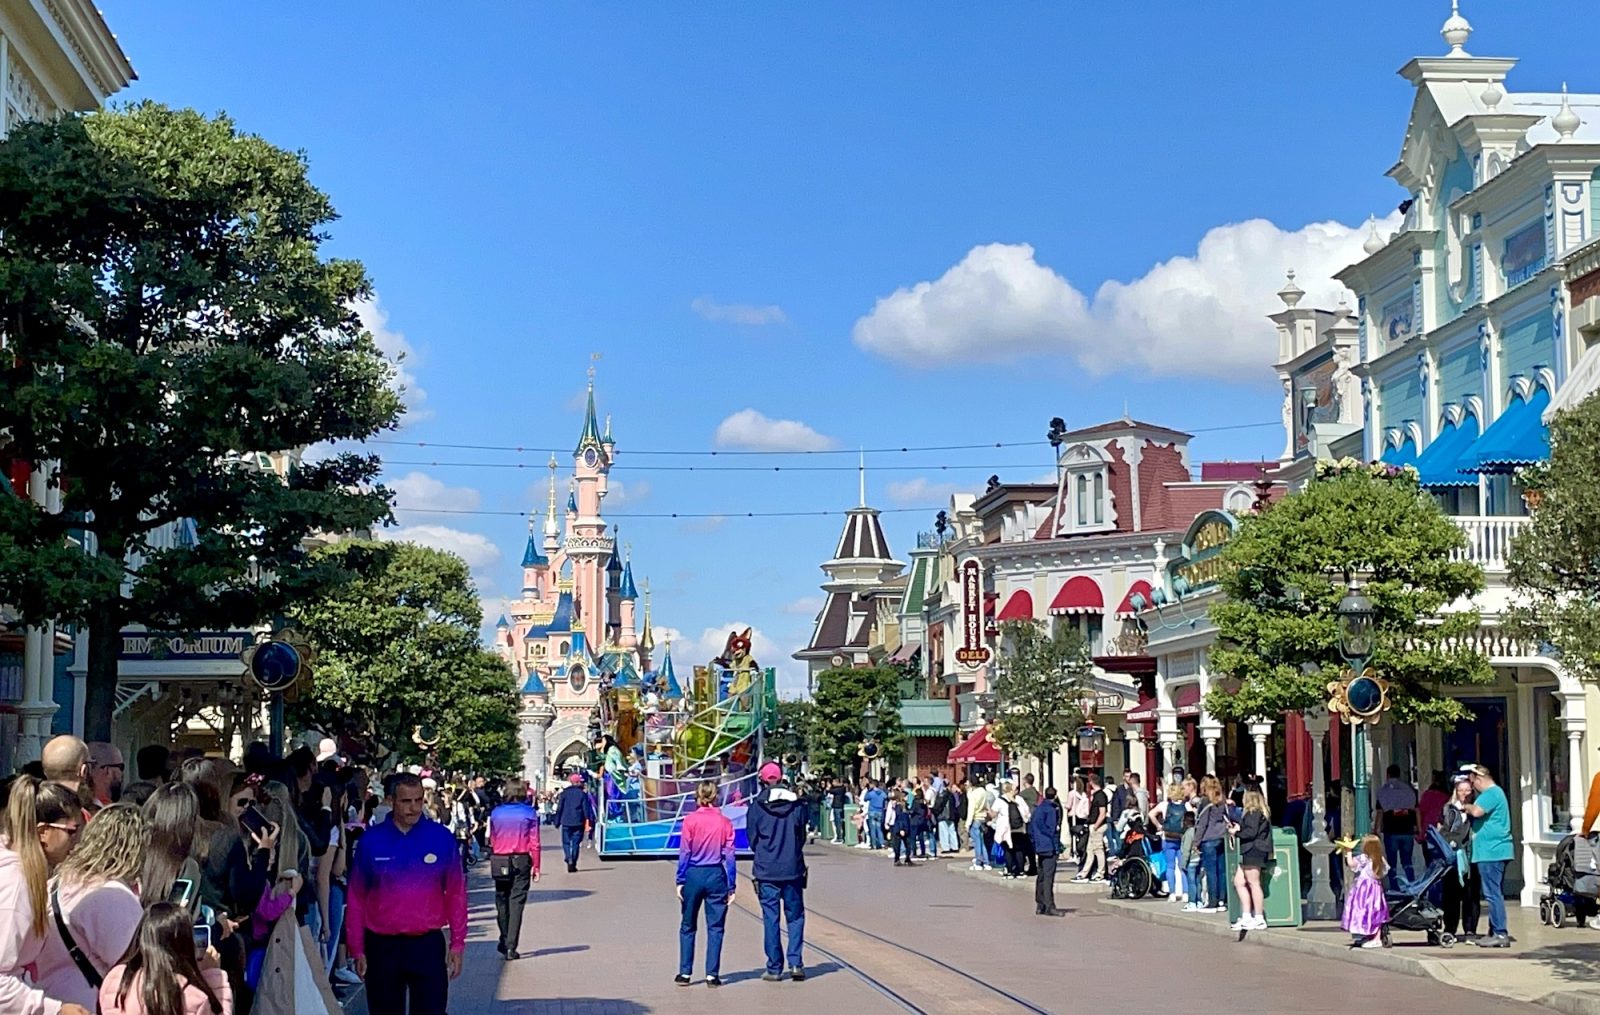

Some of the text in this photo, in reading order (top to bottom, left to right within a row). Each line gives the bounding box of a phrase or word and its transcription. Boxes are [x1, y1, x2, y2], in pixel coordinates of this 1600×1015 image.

[967, 567, 977, 611] MARKET
[121, 636, 244, 655] EMORIUM
[967, 614, 977, 650] HOUSE
[960, 650, 986, 660] DELI
